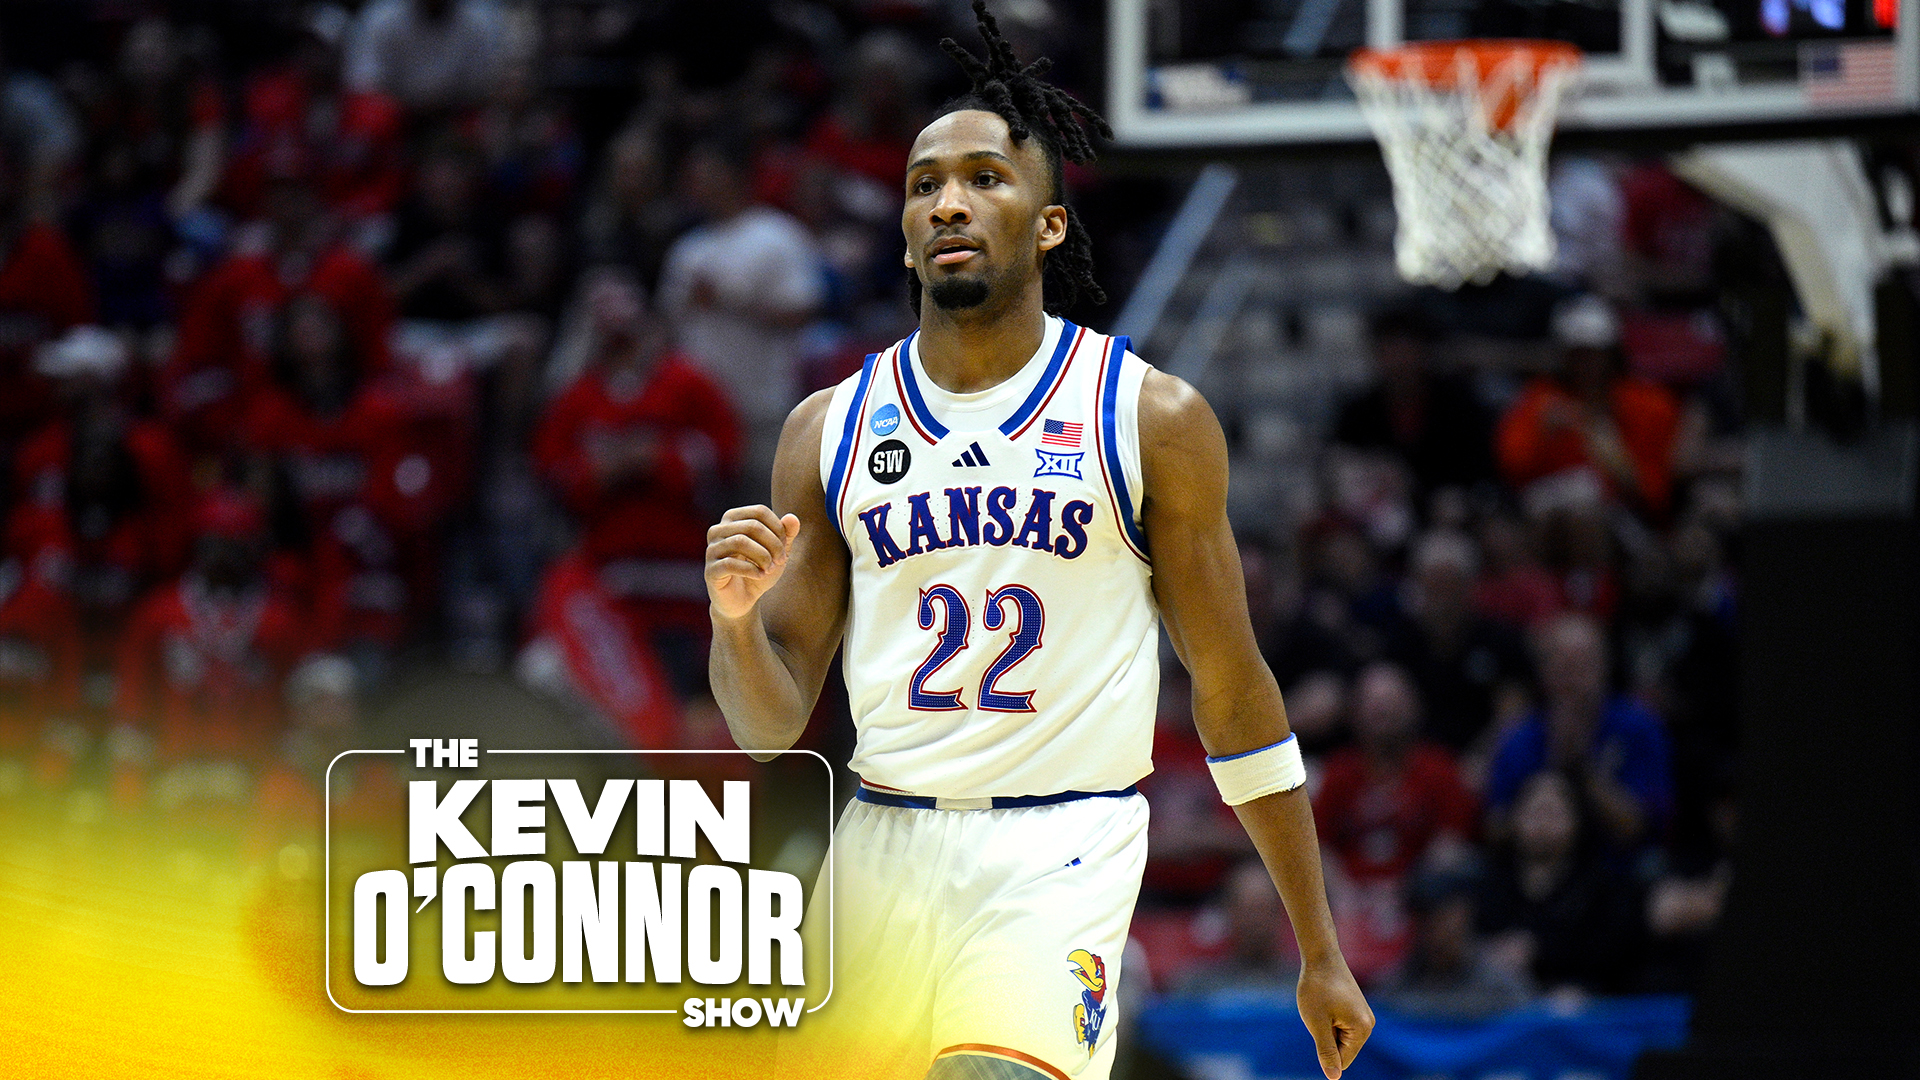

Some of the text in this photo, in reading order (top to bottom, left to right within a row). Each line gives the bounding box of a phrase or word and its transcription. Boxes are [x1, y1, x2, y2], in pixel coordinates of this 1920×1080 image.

[874, 416, 898, 429] NCAA
[873, 449, 905, 474] SW
[1034, 449, 1084, 480] XII
[858, 486, 1094, 569] KANSAS
[908, 583, 1046, 713] 22
